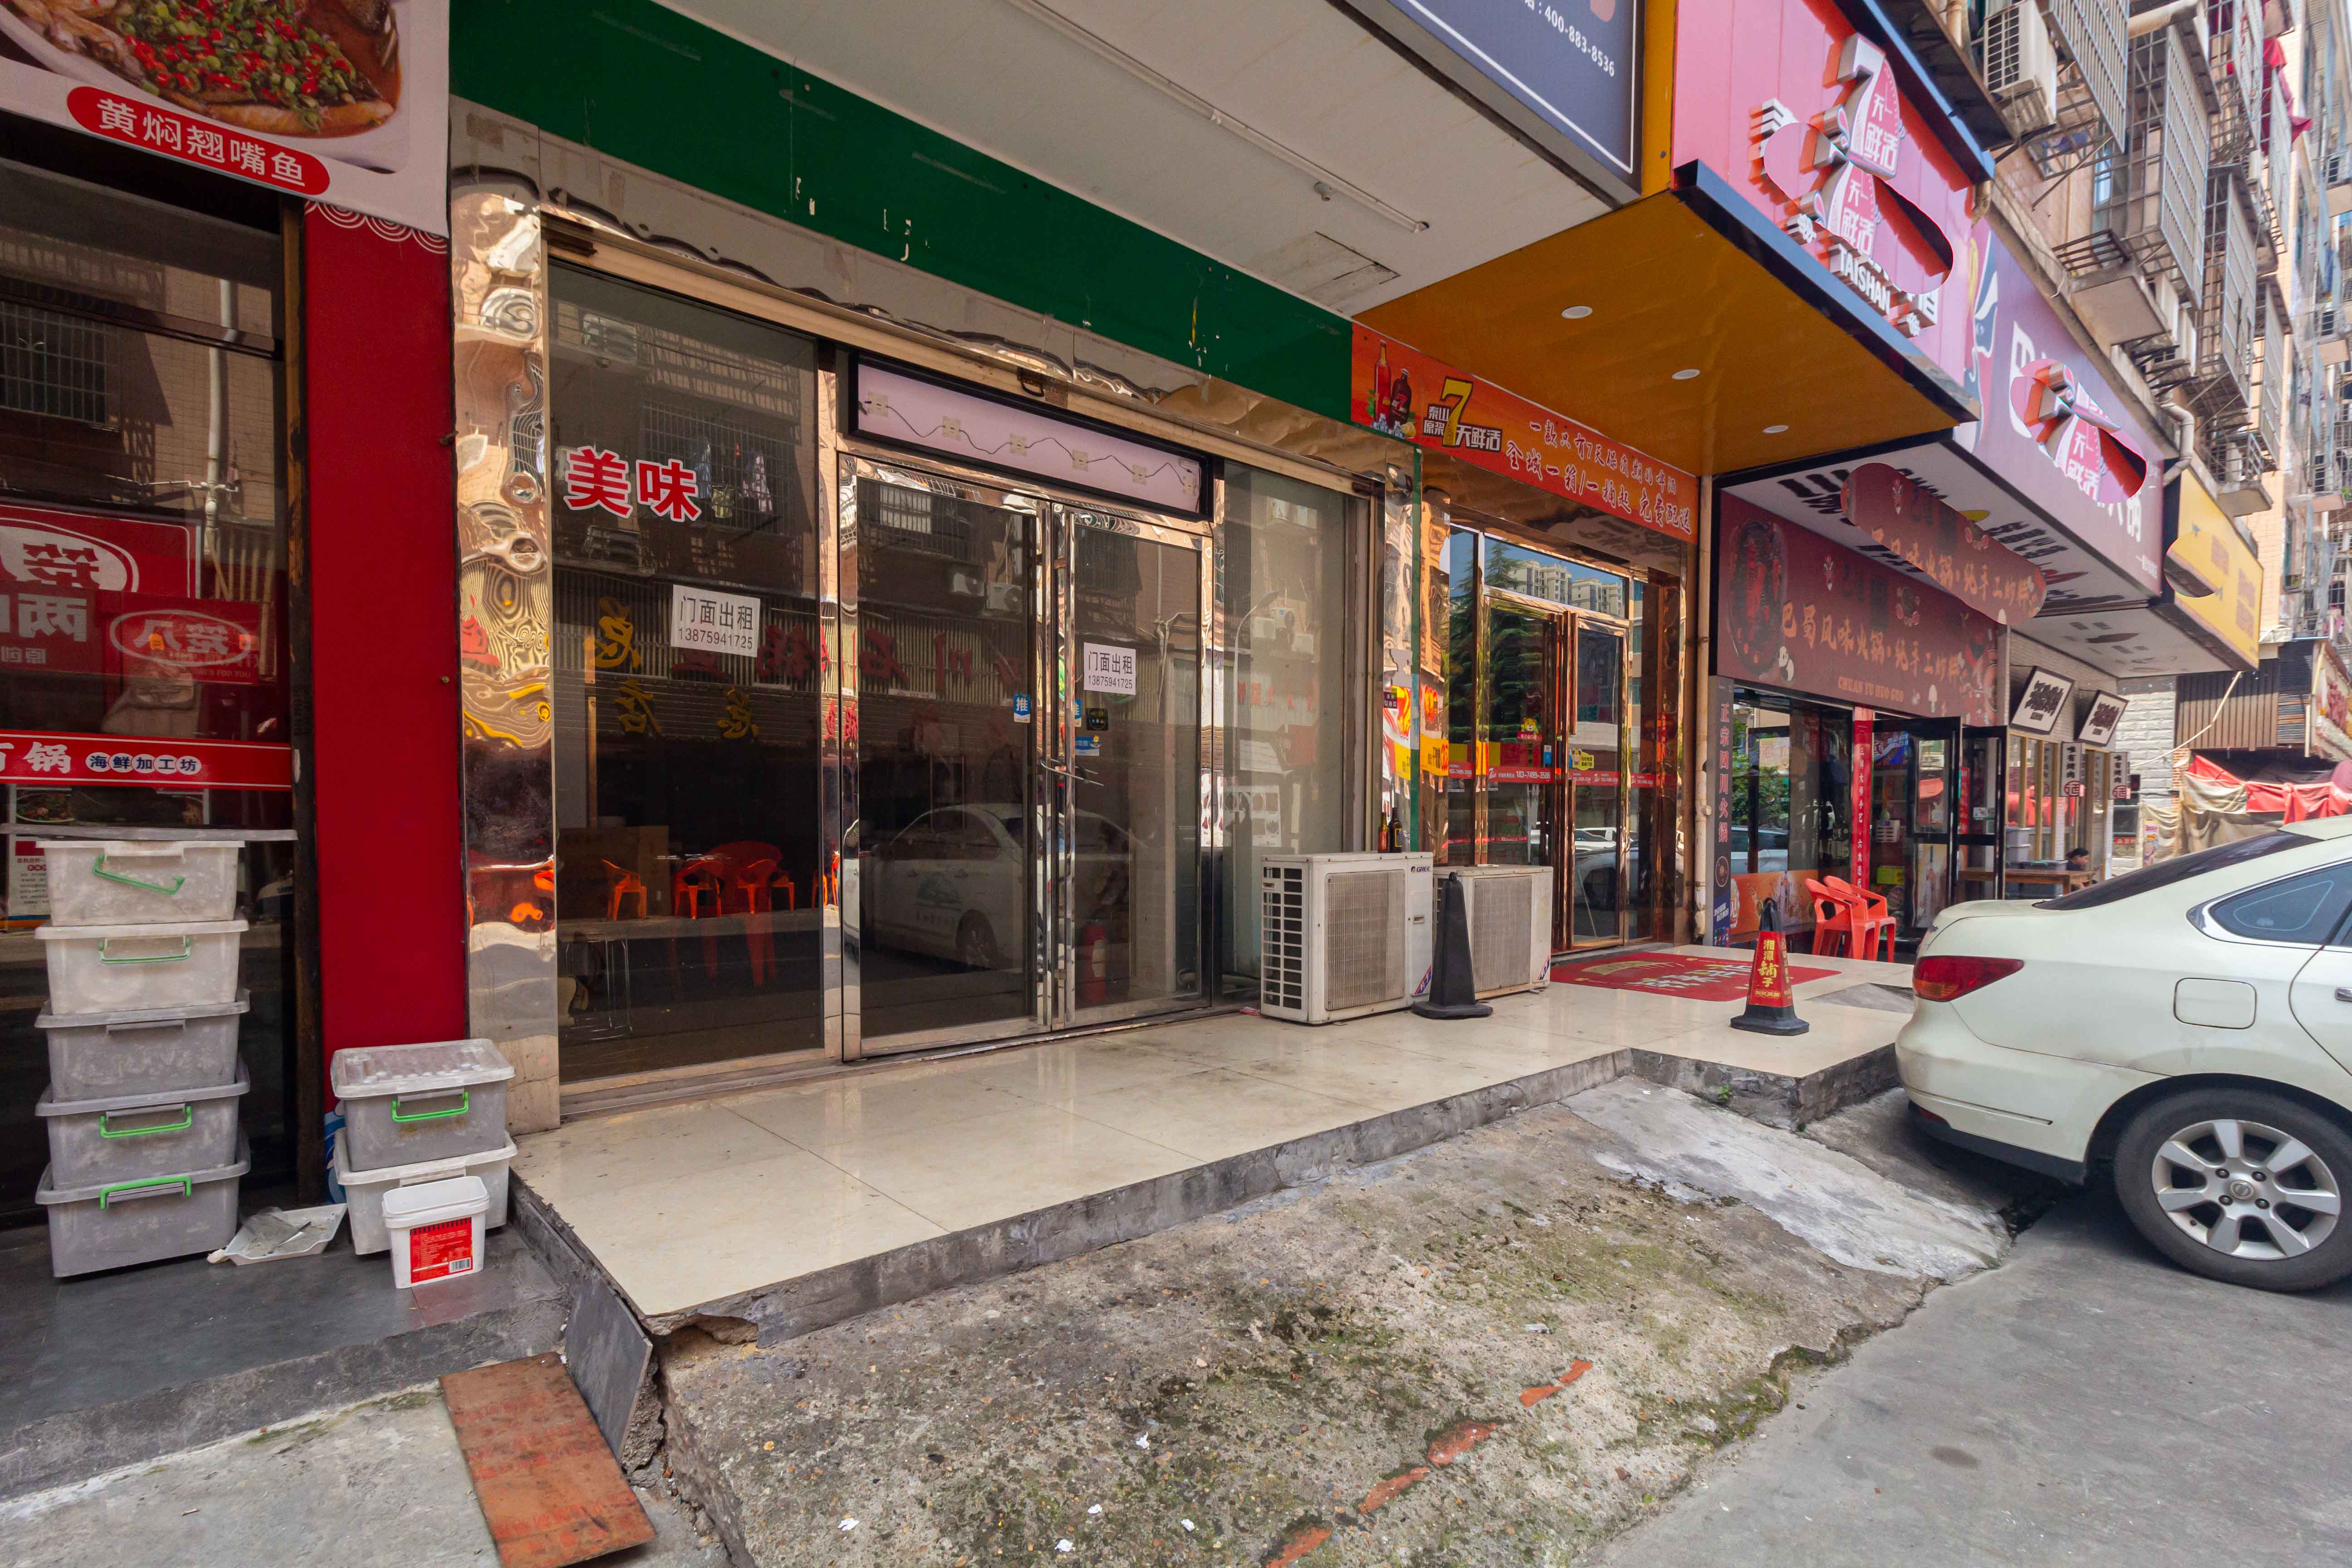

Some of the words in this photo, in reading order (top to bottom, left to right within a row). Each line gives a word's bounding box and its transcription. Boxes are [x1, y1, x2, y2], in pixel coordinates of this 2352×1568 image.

[97, 98, 305, 186] 黄焖翘嘴鱼
[1839, 244, 1891, 315] TAISHAN
[564, 446, 702, 522] 美味
[680, 596, 753, 630] 门面出租
[679, 627, 753, 649] 13875941725
[1089, 651, 1132, 675] 门面出租
[1088, 675, 1132, 689] 13875941725
[1016, 696, 1029, 712] 推
[90, 755, 197, 772] 海鲜加工坊
[1719, 703, 1730, 843] 正宗四川火锅
[1757, 939, 1779, 988] 湘潭铺子
